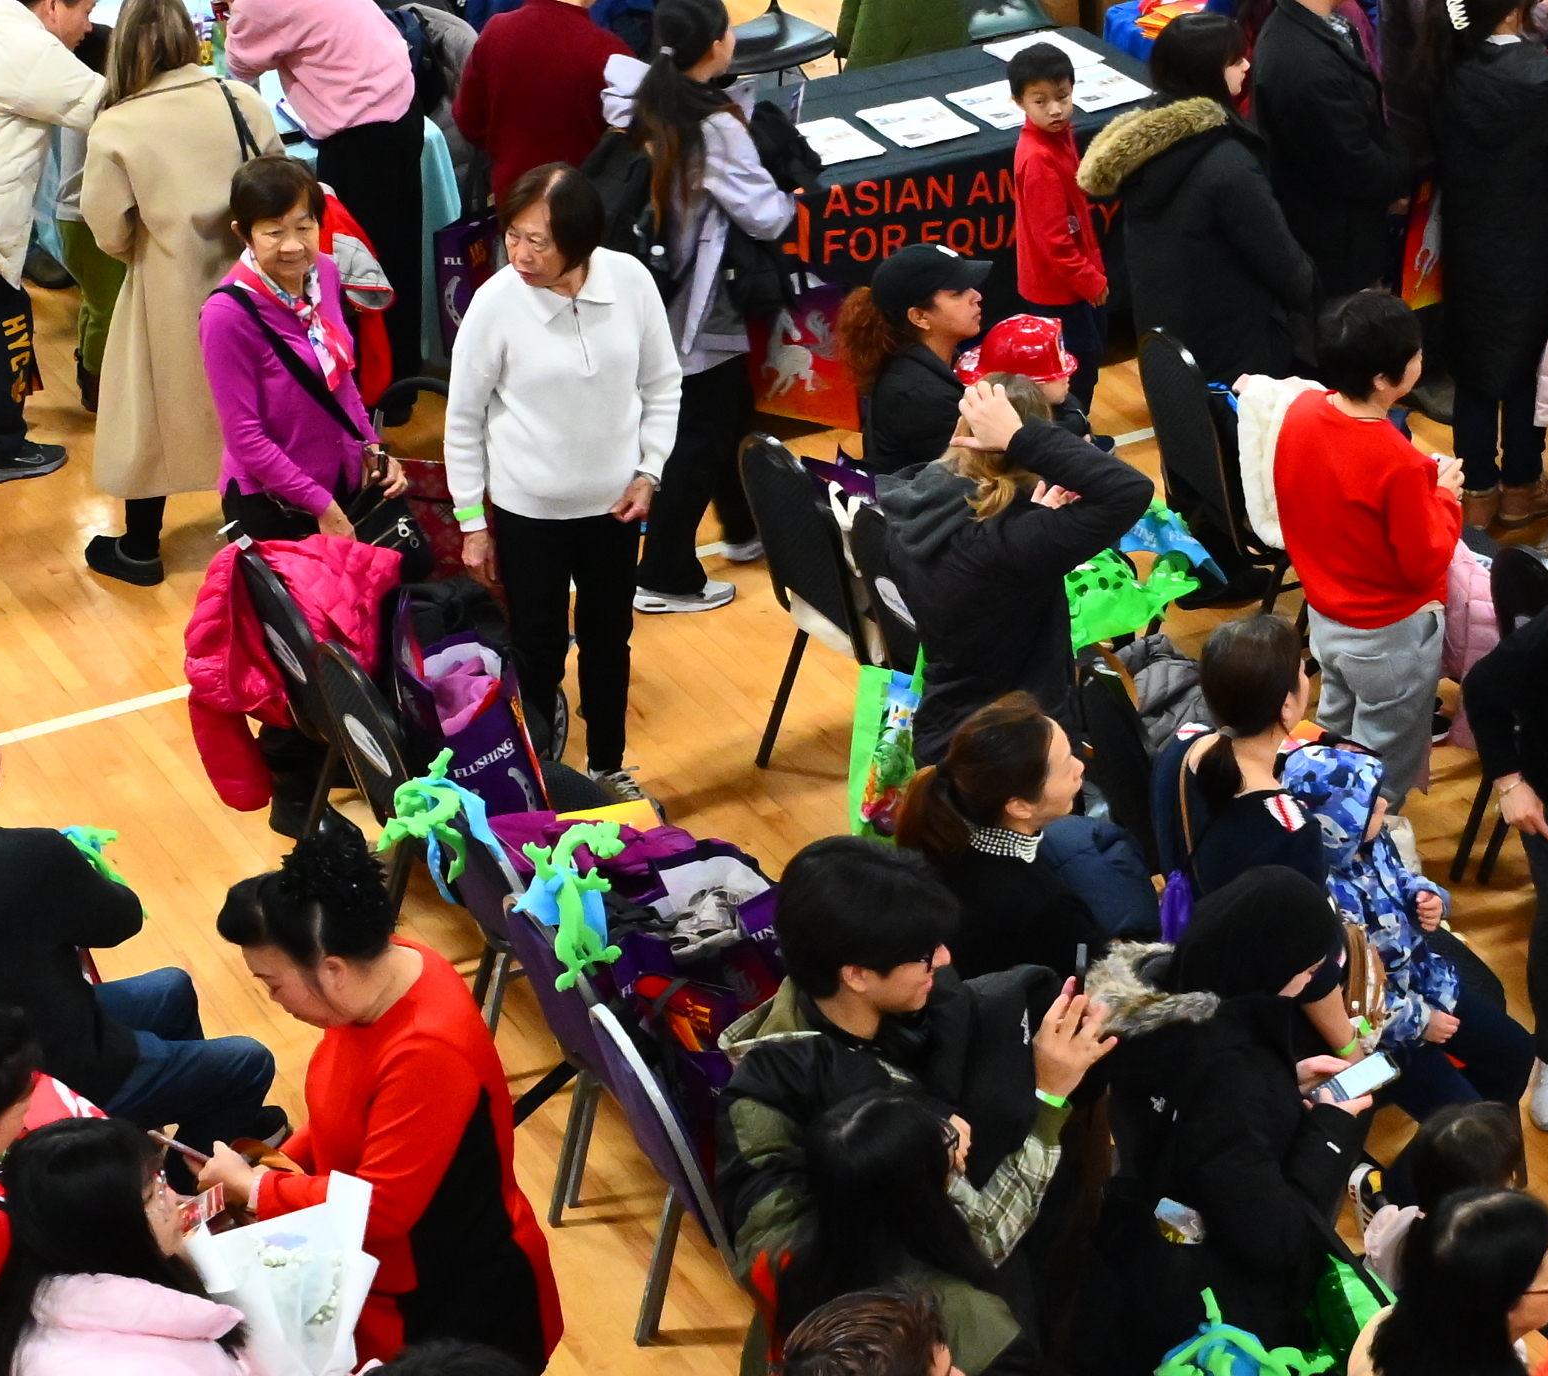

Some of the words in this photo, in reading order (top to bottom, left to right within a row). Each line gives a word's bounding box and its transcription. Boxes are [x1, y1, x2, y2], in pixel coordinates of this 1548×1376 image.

[823, 174, 954, 219] ASIAN
[823, 224, 908, 265] FOR
[453, 737, 514, 778] FLUSHING
